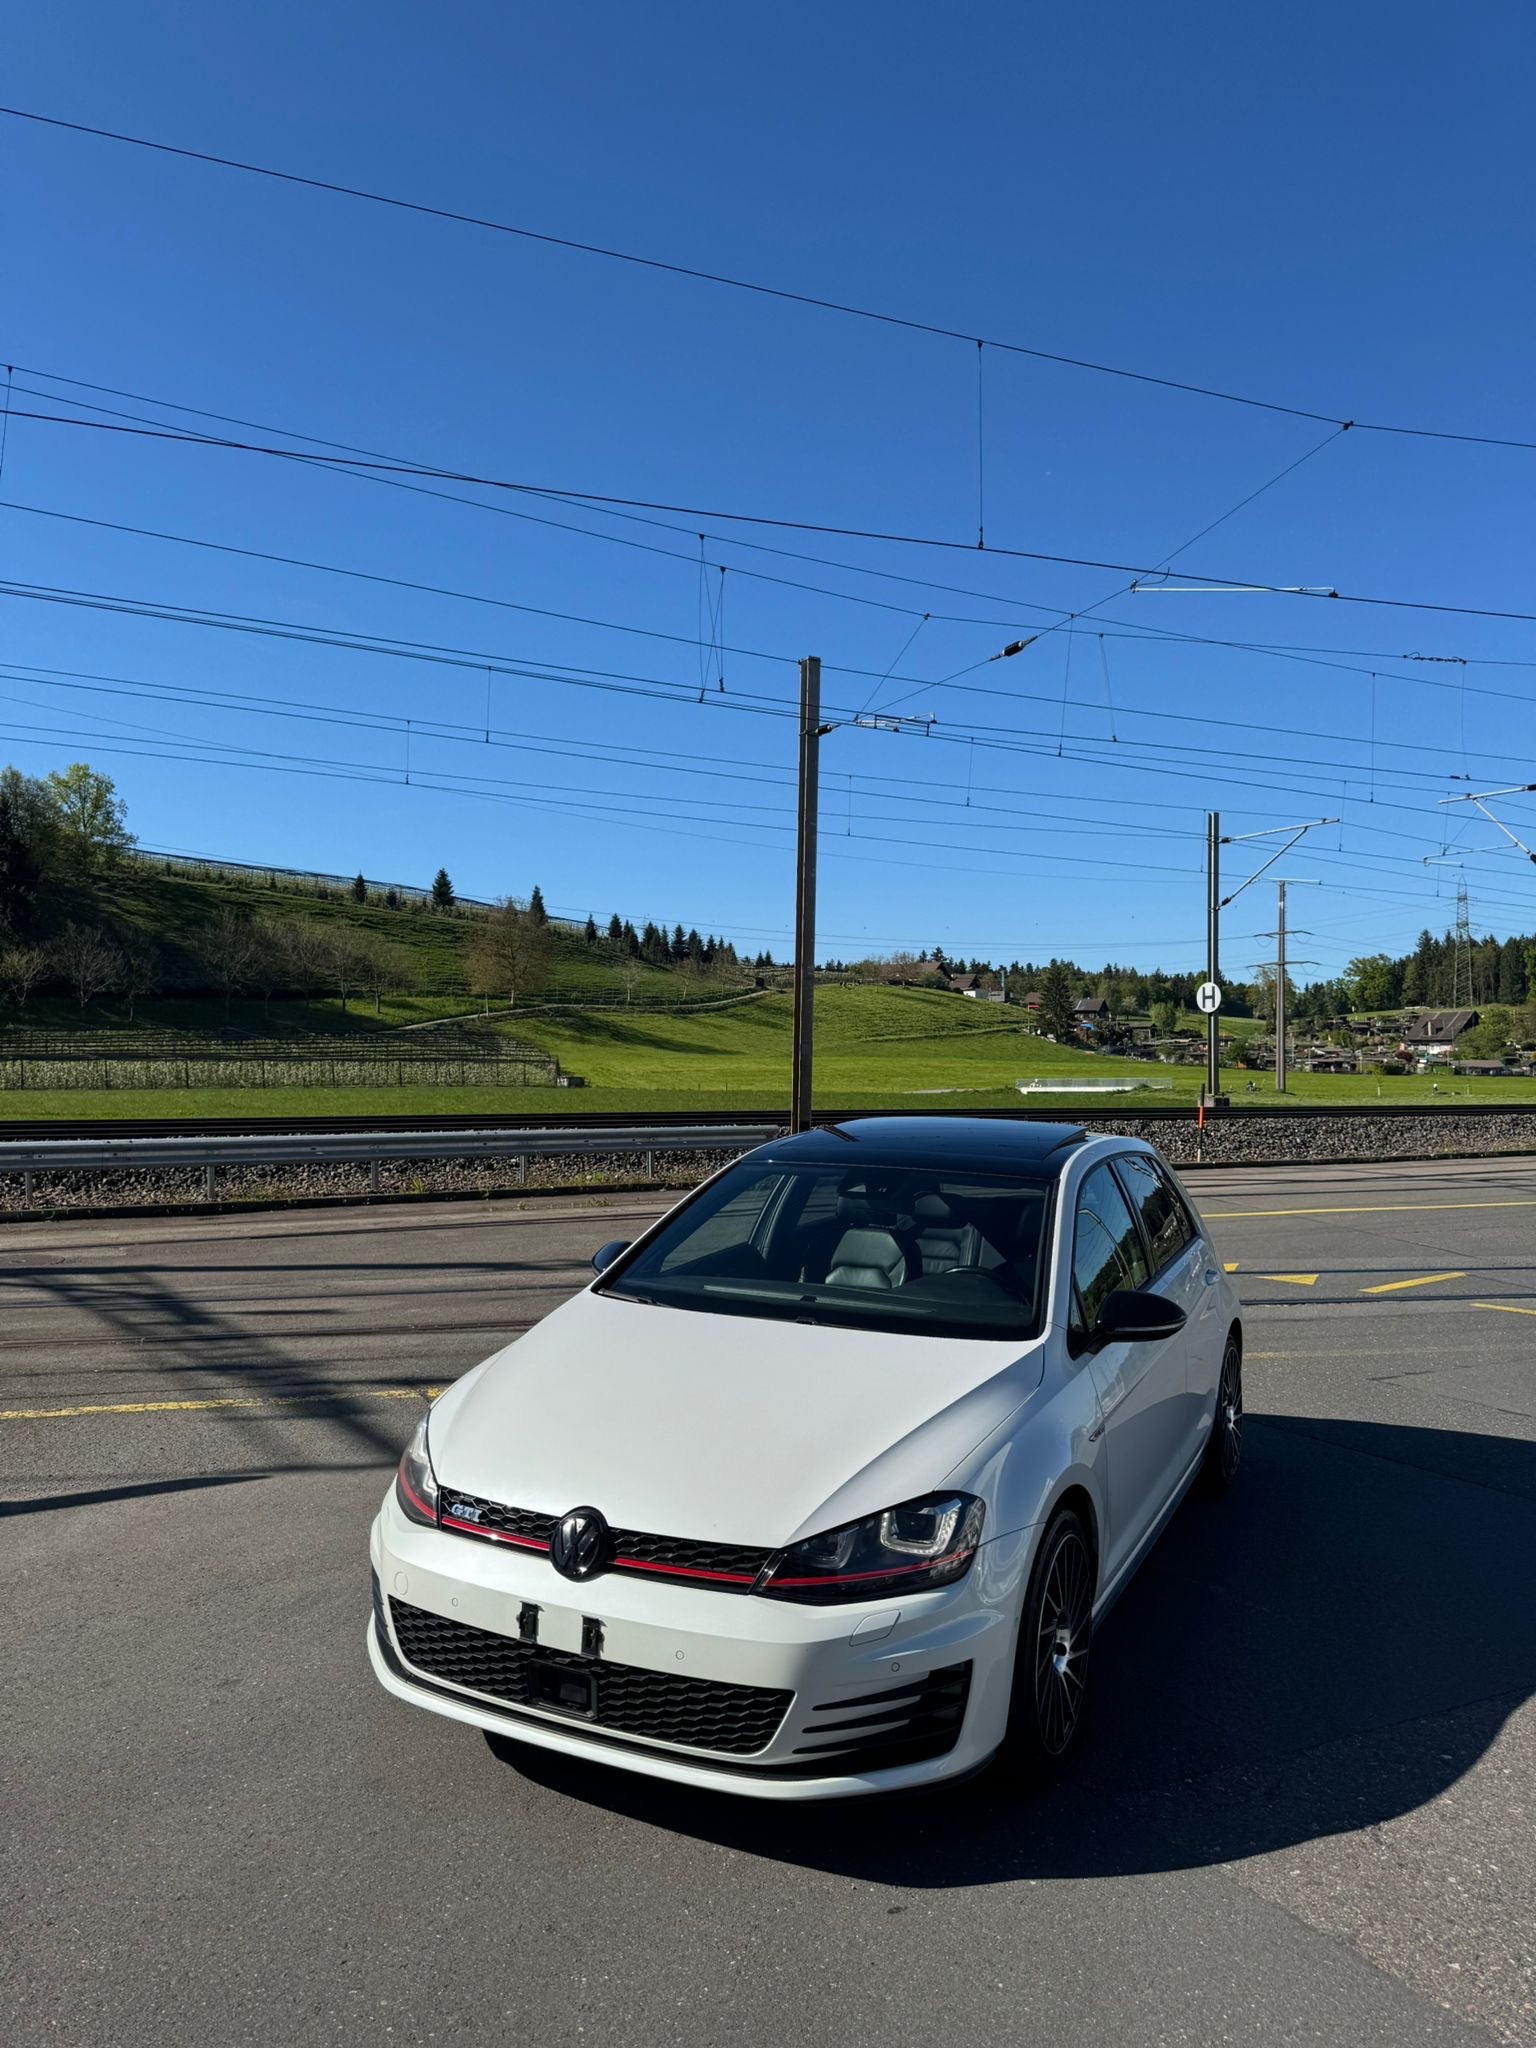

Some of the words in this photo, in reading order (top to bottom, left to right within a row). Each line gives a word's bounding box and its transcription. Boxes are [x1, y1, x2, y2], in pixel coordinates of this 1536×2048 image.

[1202, 985, 1216, 1009] H
[451, 1503, 482, 1523] GTI
[552, 1511, 603, 1578] VW
